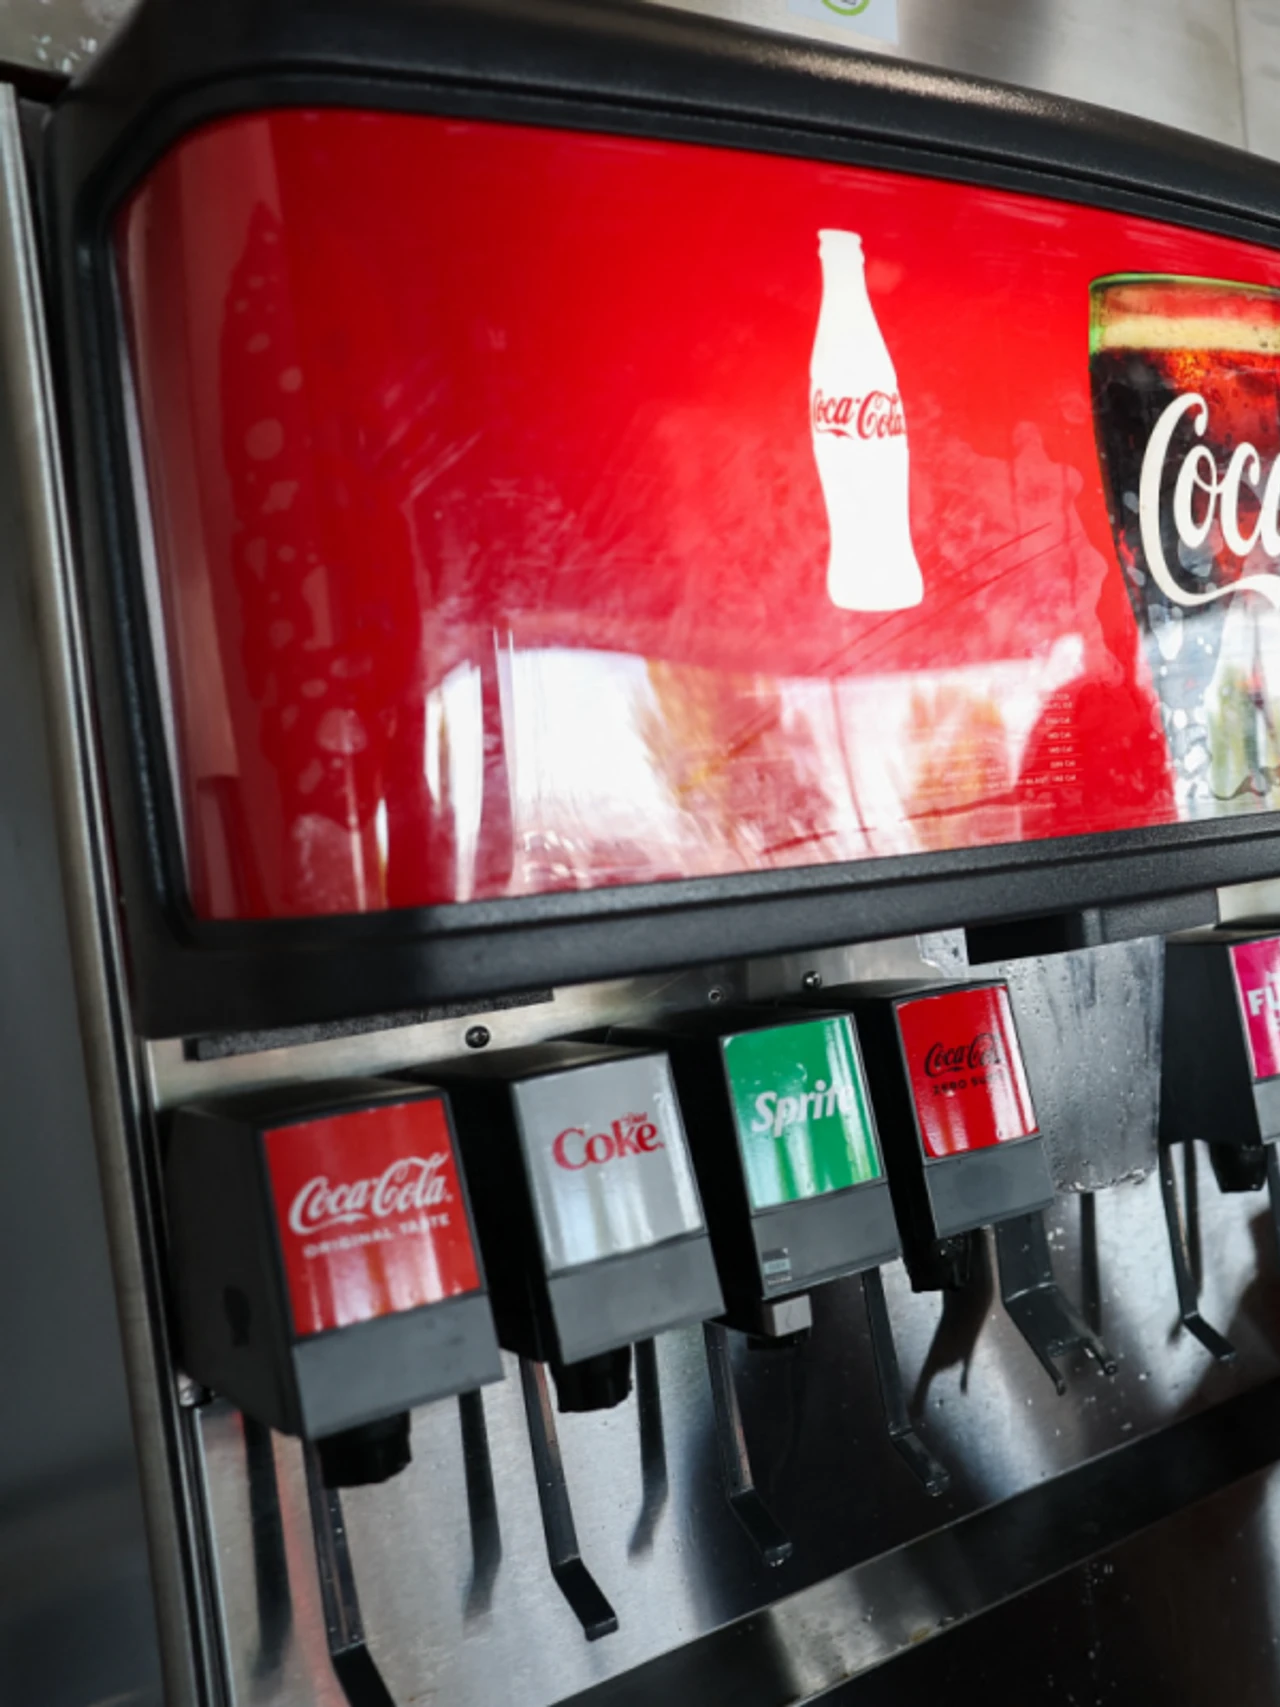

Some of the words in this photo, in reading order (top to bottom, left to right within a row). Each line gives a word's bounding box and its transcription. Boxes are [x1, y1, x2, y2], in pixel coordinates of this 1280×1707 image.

[813, 388, 905, 440] Coca-Cola
[924, 1033, 1003, 1078] Coca-Col
[552, 1119, 664, 1171] Coke
[288, 1152, 449, 1235] Coca-Cola
[303, 1227, 393, 1259] ORIGINAL
